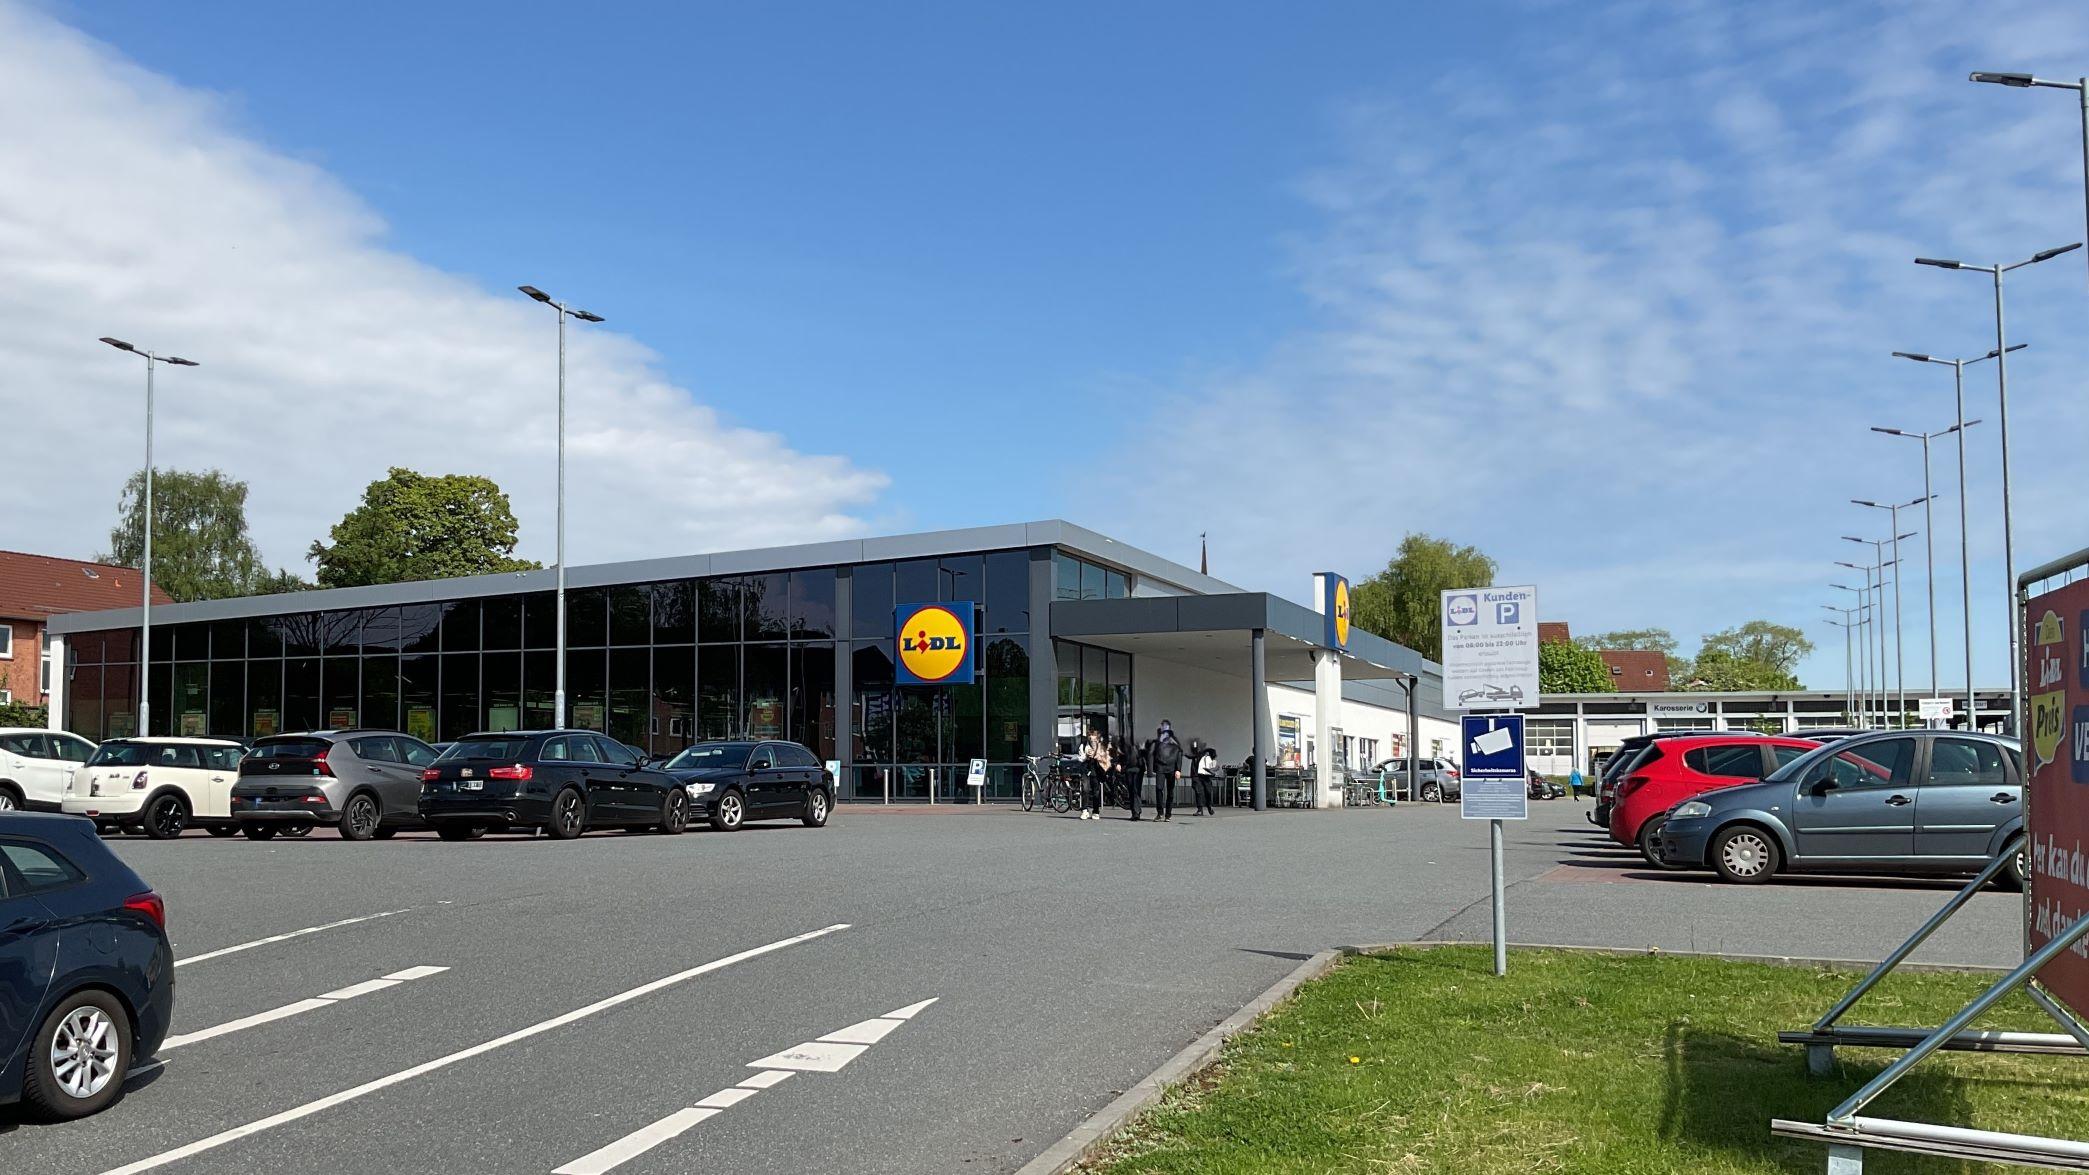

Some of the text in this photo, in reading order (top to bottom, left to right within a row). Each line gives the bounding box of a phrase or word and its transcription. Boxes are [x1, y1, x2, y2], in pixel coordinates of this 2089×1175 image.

[1484, 592, 1531, 602] Kunden-
[1501, 604, 1515, 624] P
[2048, 834, 2068, 880] kan
[2071, 839, 2086, 887] du
